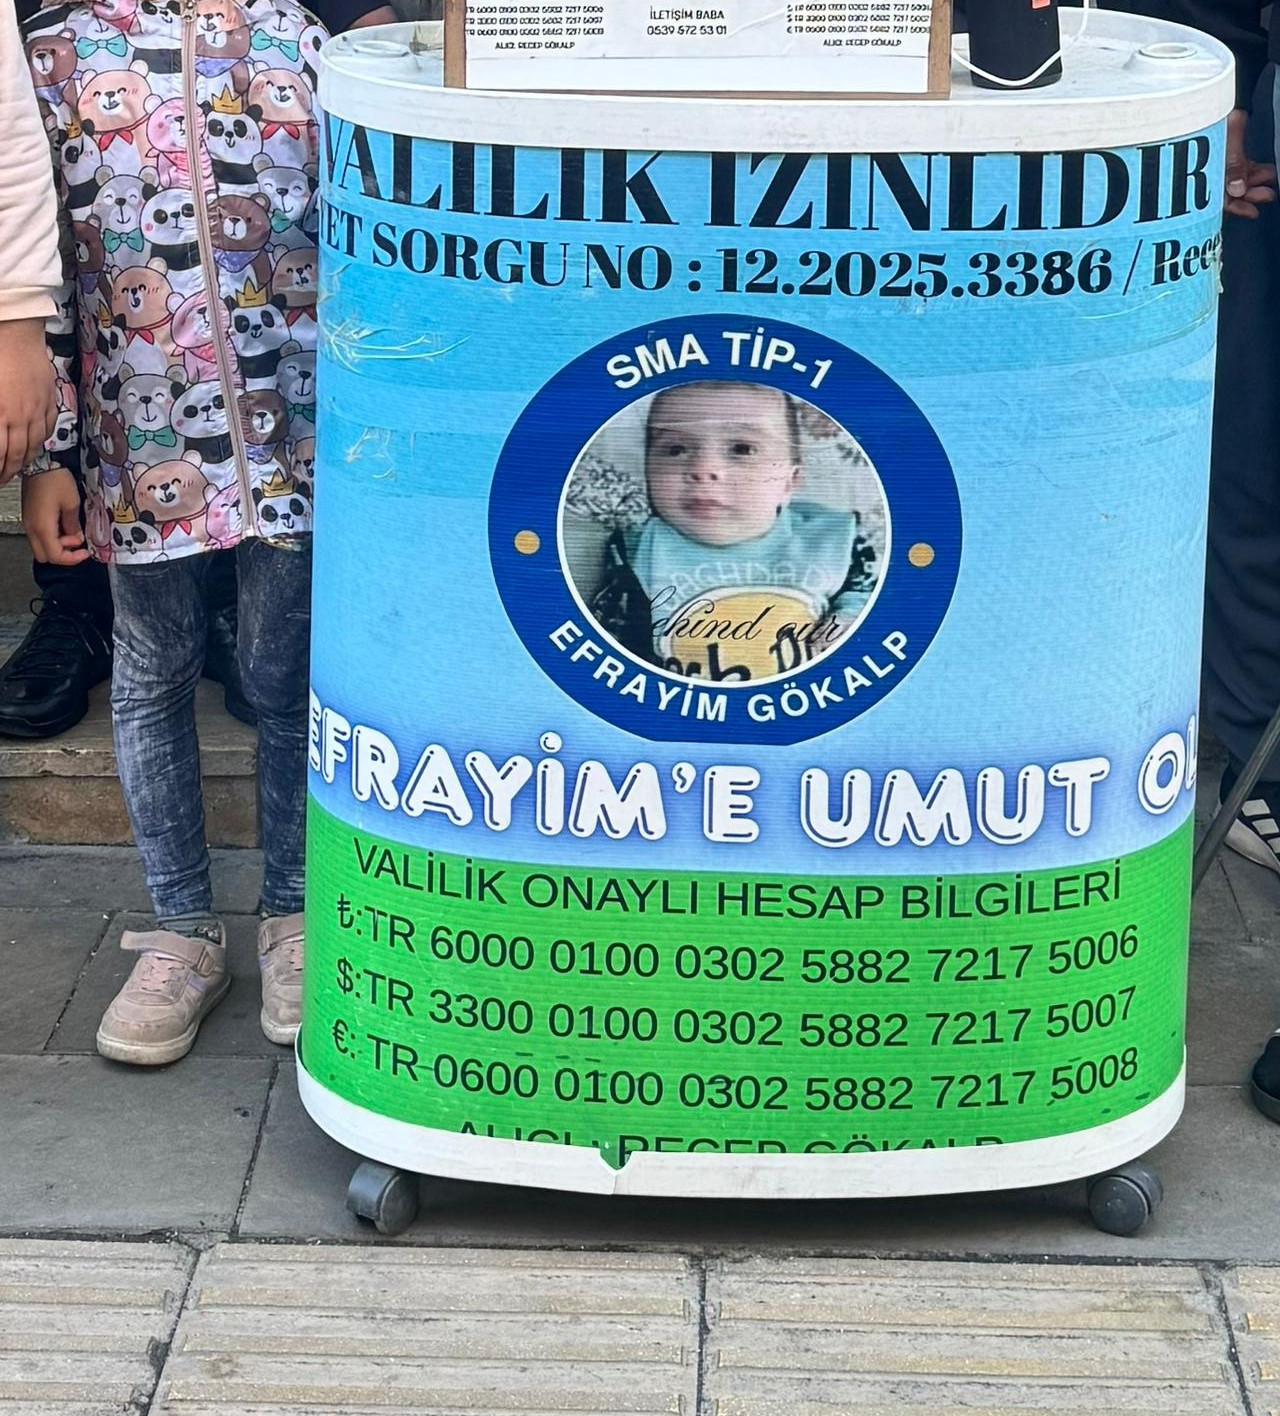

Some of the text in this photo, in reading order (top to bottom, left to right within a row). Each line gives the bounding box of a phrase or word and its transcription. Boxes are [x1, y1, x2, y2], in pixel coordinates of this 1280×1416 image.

[695, 9, 725, 20] BABA
[320, 195, 363, 258] ET
[715, 247, 1113, 298] 12.2025.3386
[606, 326, 833, 390] SMA TİP-1
[548, 619, 728, 723] EFRAYİM
[746, 630, 910, 723] GÖKALP
[799, 756, 1111, 848] UMUT
[353, 836, 1122, 920] VALİLİK ONAYLI HESAP BİLGİLERİ
[430, 925, 535, 972] 6000
[549, 939, 660, 978] 0100
[675, 944, 785, 981] 0302
[801, 948, 911, 984] 5882
[927, 944, 1034, 983] 7217
[1047, 924, 1139, 975] 5006
[428, 989, 534, 1034] 3300
[548, 1004, 658, 1042] 0100
[673, 1008, 784, 1046] 0302
[799, 1012, 909, 1048] 5882
[925, 1008, 1032, 1047] 7217
[1046, 986, 1137, 1039] 5007
[434, 1053, 539, 1099] 0600
[554, 1067, 664, 1107] 0100
[679, 1073, 789, 1110] 0302
[805, 1076, 914, 1112] 5882
[931, 1070, 1037, 1110] 7217
[1050, 1047, 1138, 1102] 5008
